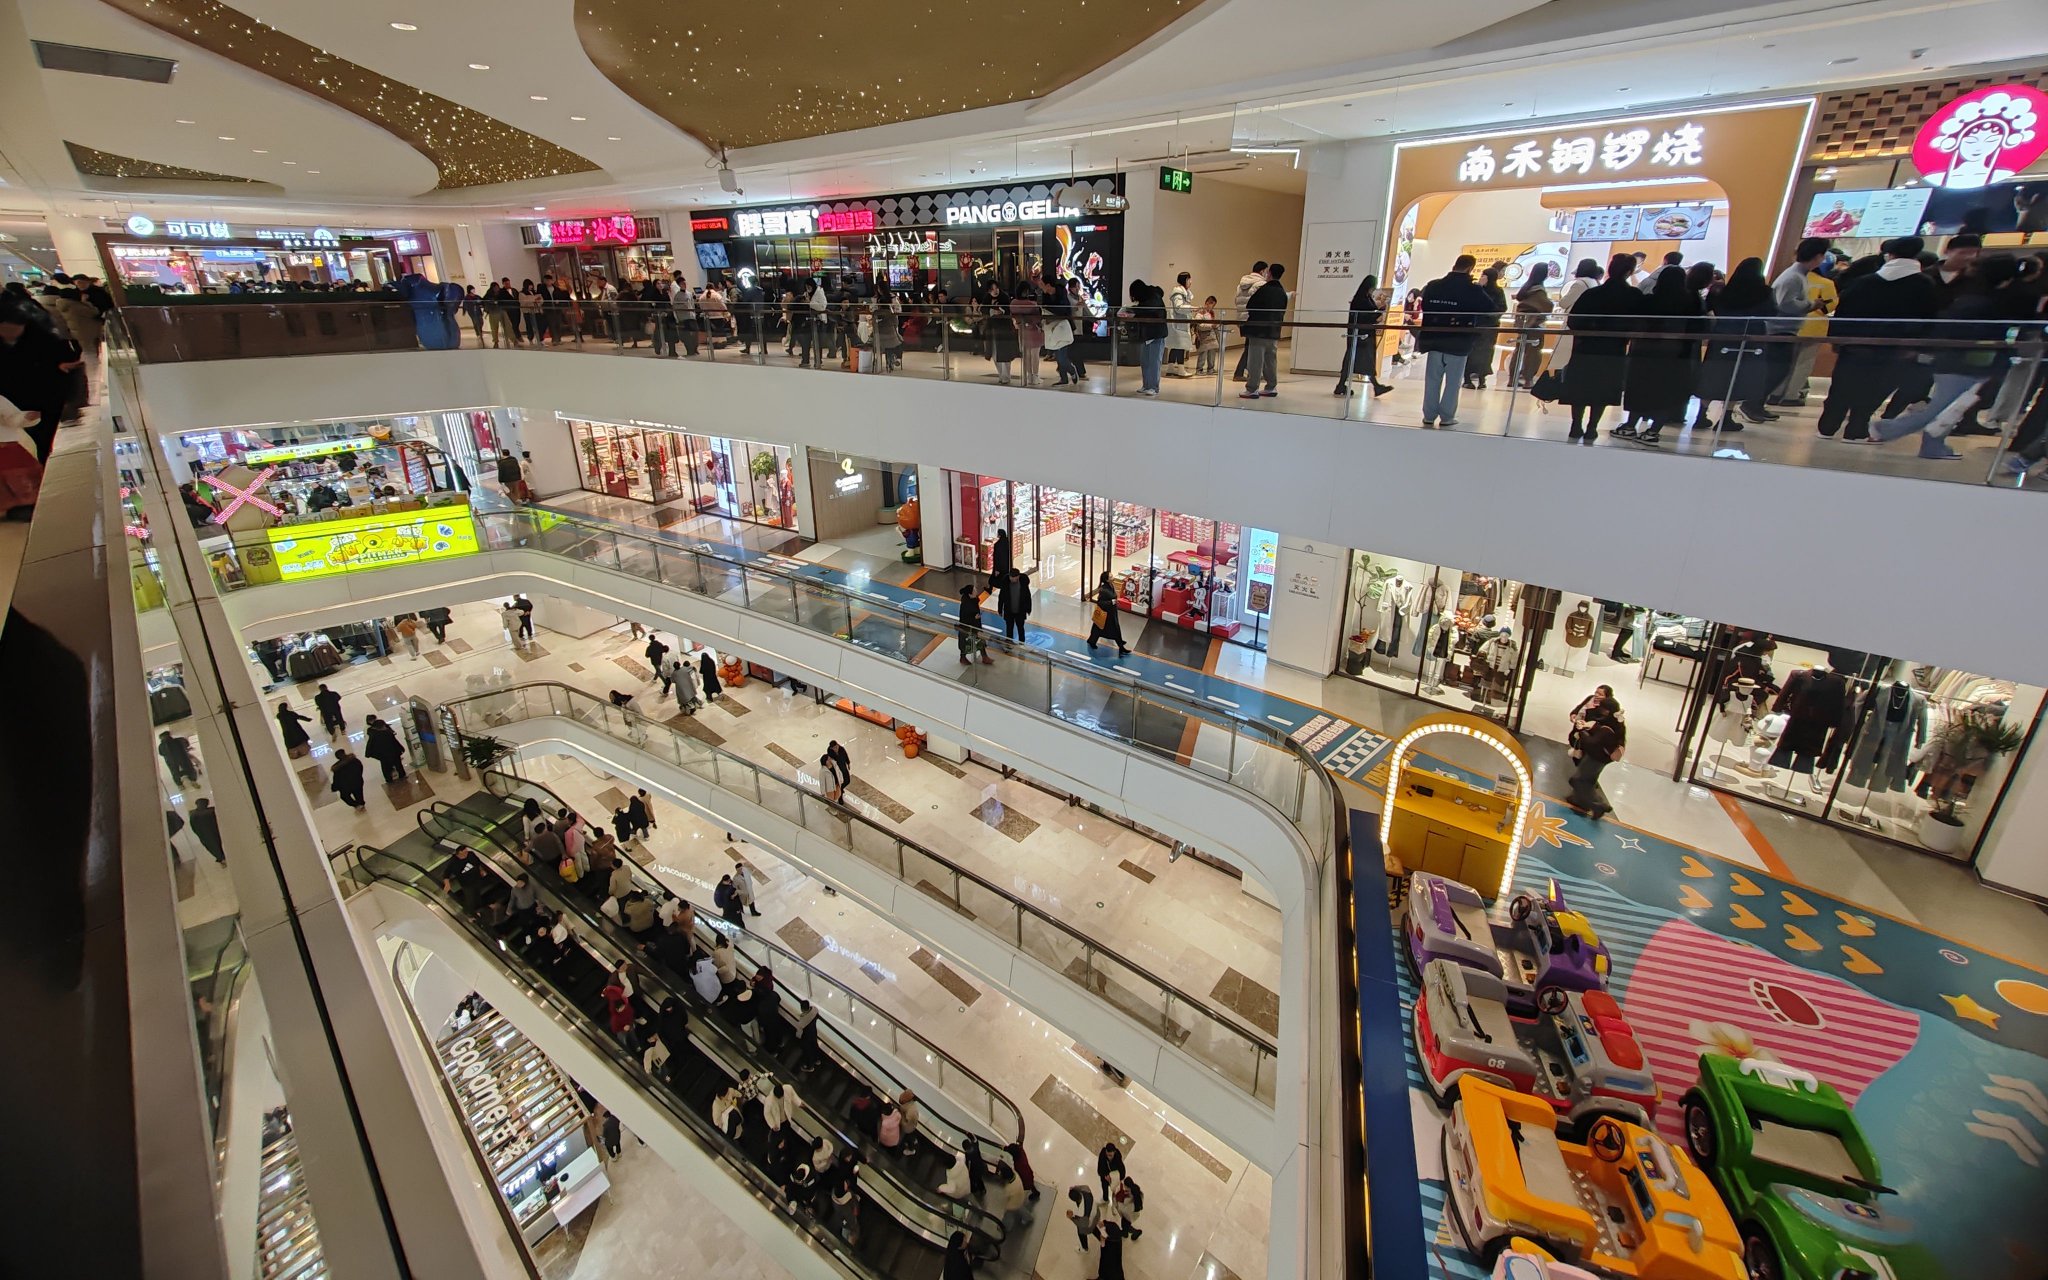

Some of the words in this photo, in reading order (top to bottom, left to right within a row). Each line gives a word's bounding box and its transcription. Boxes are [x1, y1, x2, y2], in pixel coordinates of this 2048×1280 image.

[1458, 122, 1705, 182] 南禾铜锣烧
[946, 203, 1002, 225] PANG
[1325, 250, 1350, 258] 消火栓
[1487, 1058, 1506, 1069] 08
[450, 1036, 510, 1123] Goodme
